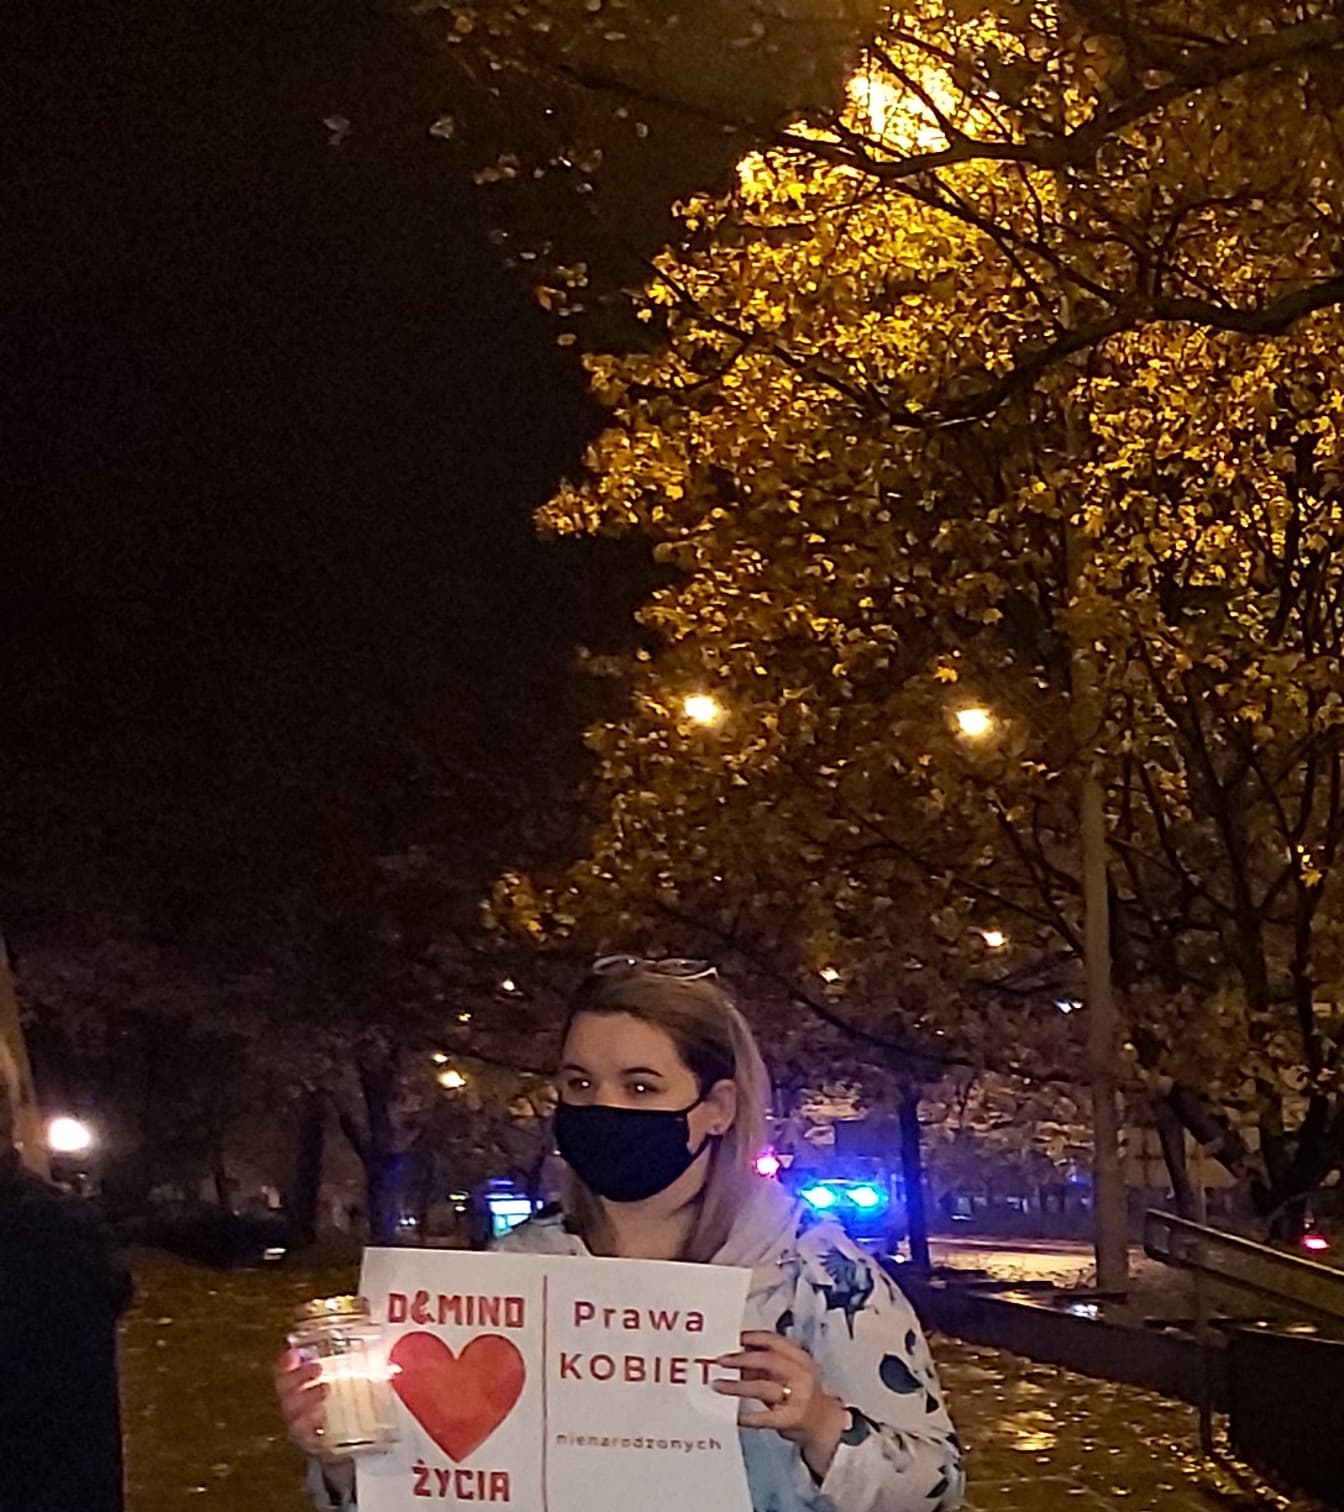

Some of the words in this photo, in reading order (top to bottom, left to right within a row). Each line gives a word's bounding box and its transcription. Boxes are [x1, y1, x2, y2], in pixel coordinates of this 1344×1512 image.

[574, 1301, 704, 1332] Prawa
[559, 1352, 718, 1385] KOBIET
[555, 1433, 723, 1453] nienarodzonych
[412, 1459, 511, 1502] ŻYCIA
